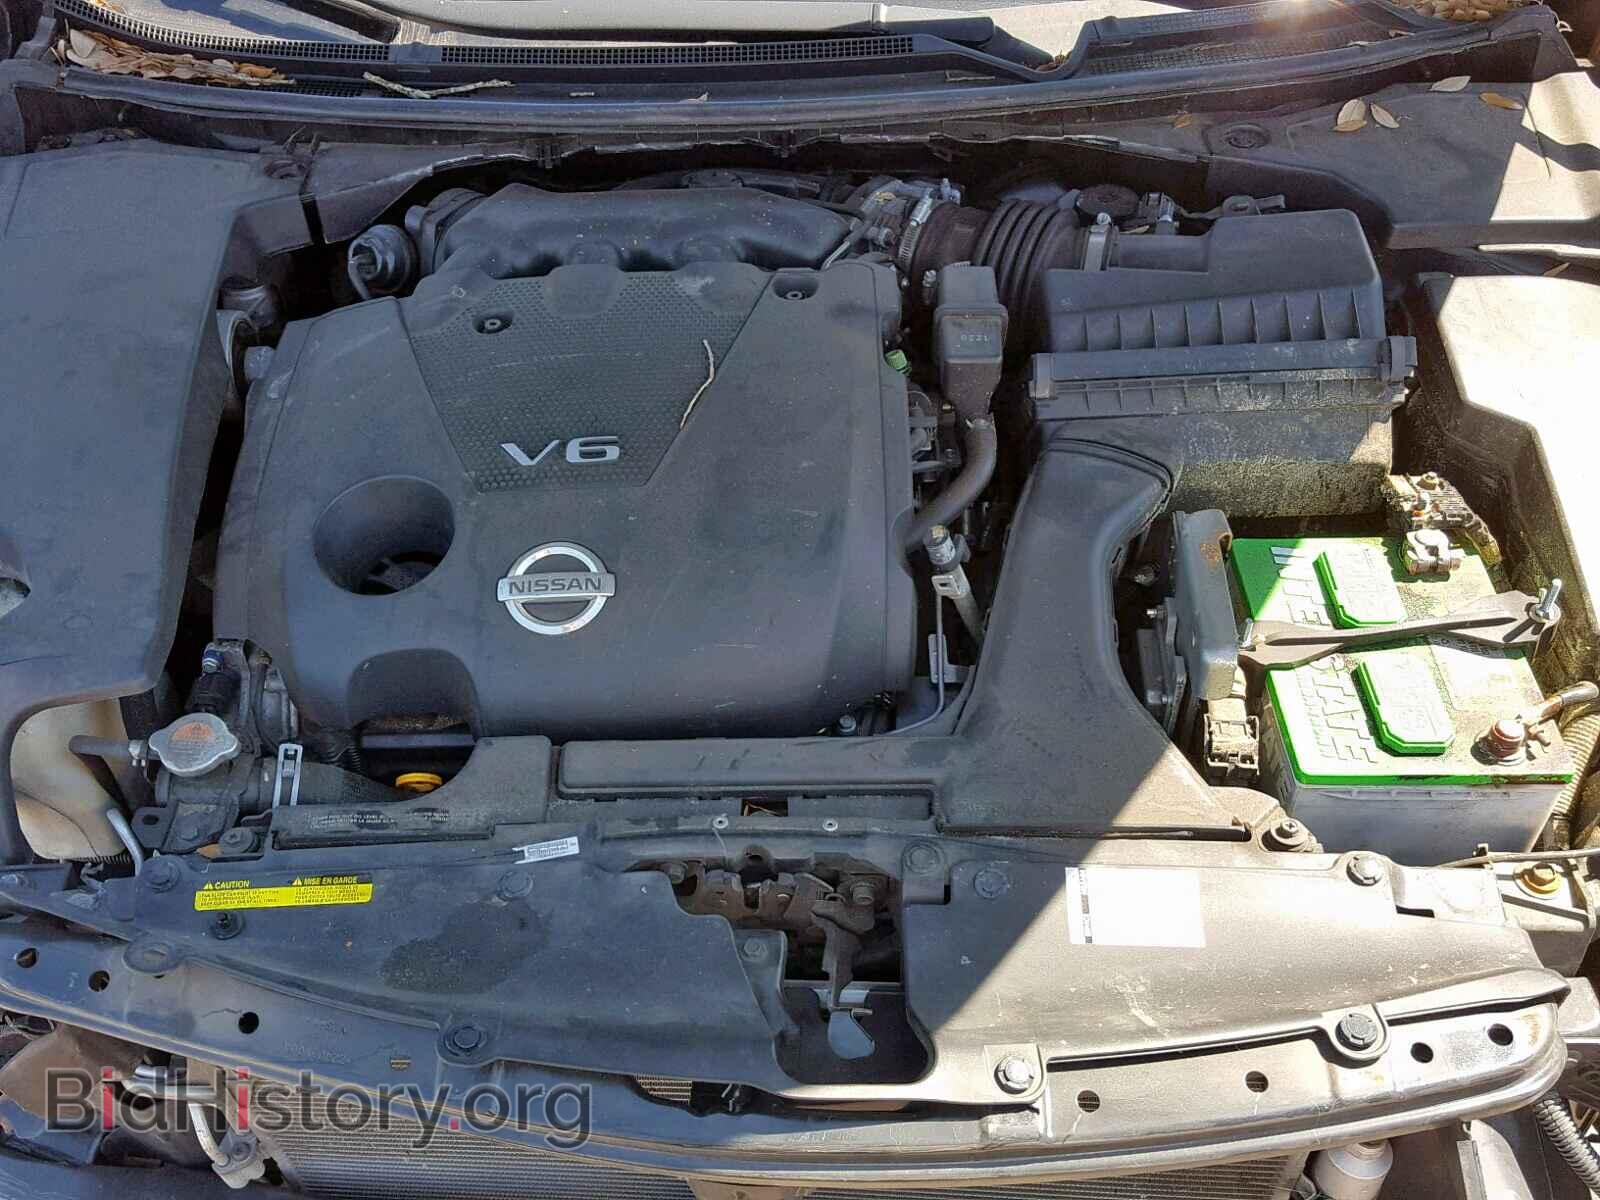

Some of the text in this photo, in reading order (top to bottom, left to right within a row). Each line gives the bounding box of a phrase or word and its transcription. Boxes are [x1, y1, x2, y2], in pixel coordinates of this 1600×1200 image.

[501, 436, 620, 465] V6
[508, 577, 602, 595] NISSAN
[214, 880, 250, 890] CAUTION
[303, 875, 357, 887] MISE EN GARDE
